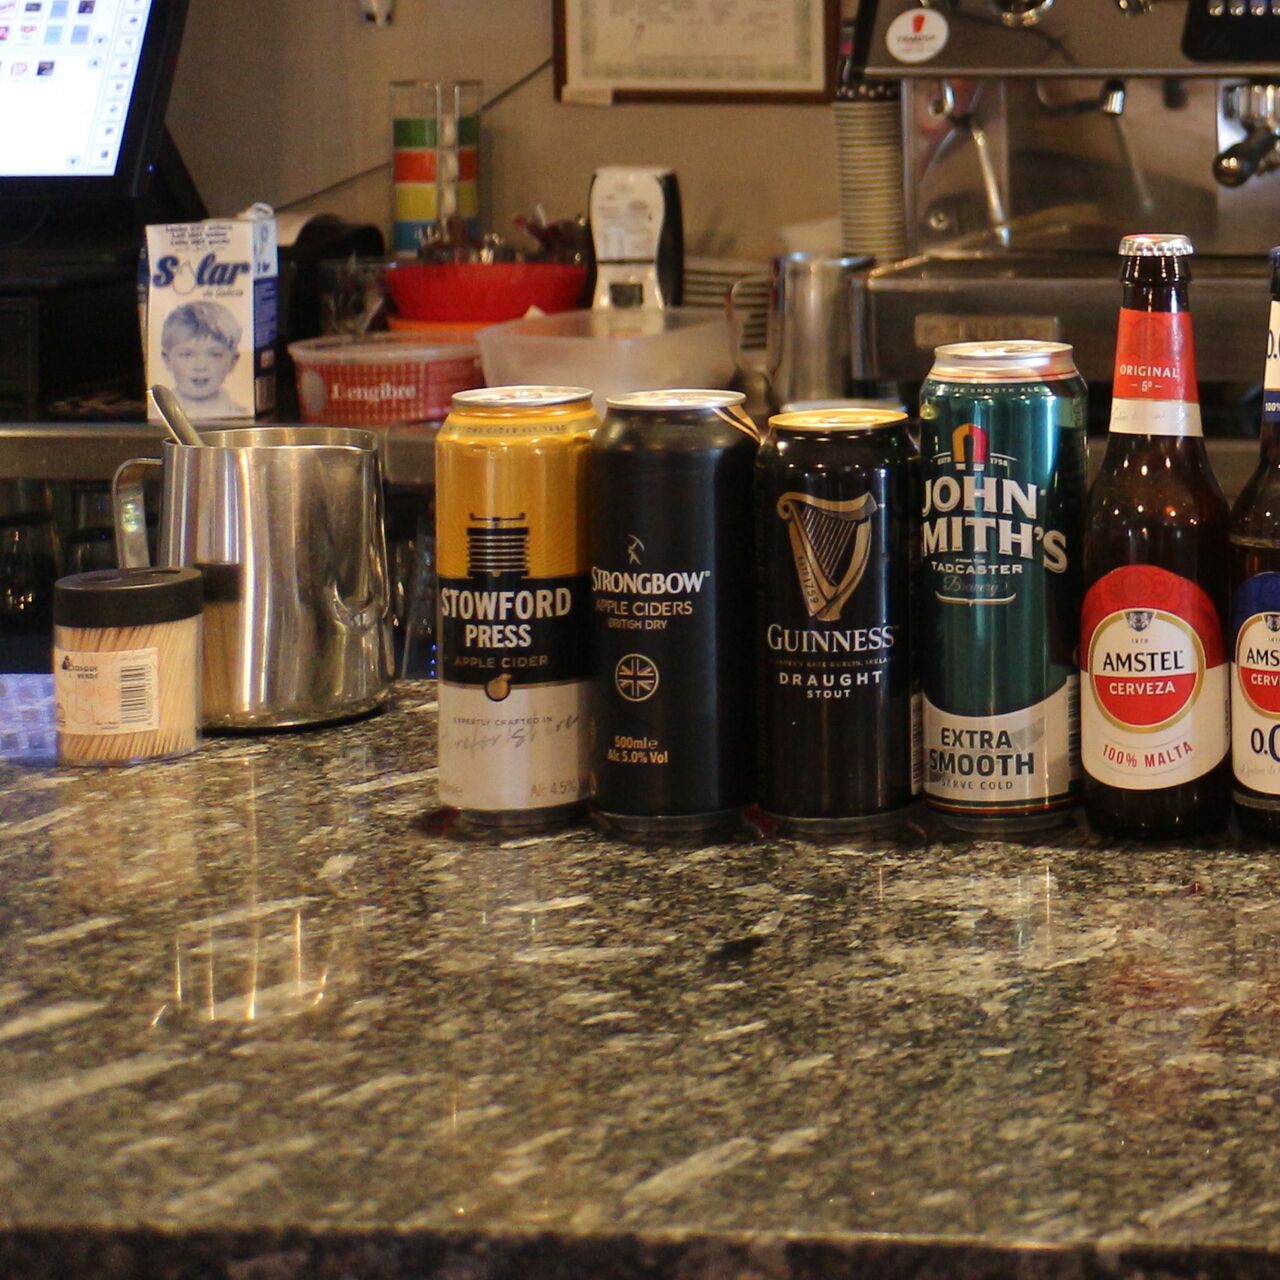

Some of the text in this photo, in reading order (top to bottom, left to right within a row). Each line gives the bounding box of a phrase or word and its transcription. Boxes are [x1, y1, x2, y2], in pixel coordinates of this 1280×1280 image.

[1119, 363, 1180, 379] ORIGINAL
[922, 476, 1038, 520] JOHN
[921, 517, 1069, 575] MITH'S
[931, 561, 1023, 575] TADCASTER
[591, 567, 705, 594] STRONGBOW
[441, 587, 573, 620] STOWFORD
[633, 601, 693, 616] CIDERS
[645, 620, 668, 630] DRY
[465, 624, 532, 648] PRESS
[767, 624, 895, 652] GUINNESS
[454, 655, 549, 668] APPLE CIDER
[1103, 650, 1184, 672] AMSTEL
[779, 671, 883, 686] DRAUGHT
[1109, 680, 1176, 695] CERVEZA
[807, 689, 851, 699] STOUT
[941, 727, 1012, 749] EXTRA
[622, 750, 668, 764] 5.0% Vol
[929, 749, 1034, 777] SMOOTH
[1102, 740, 1193, 768] 100% MALTA
[980, 781, 1013, 790] COLD
